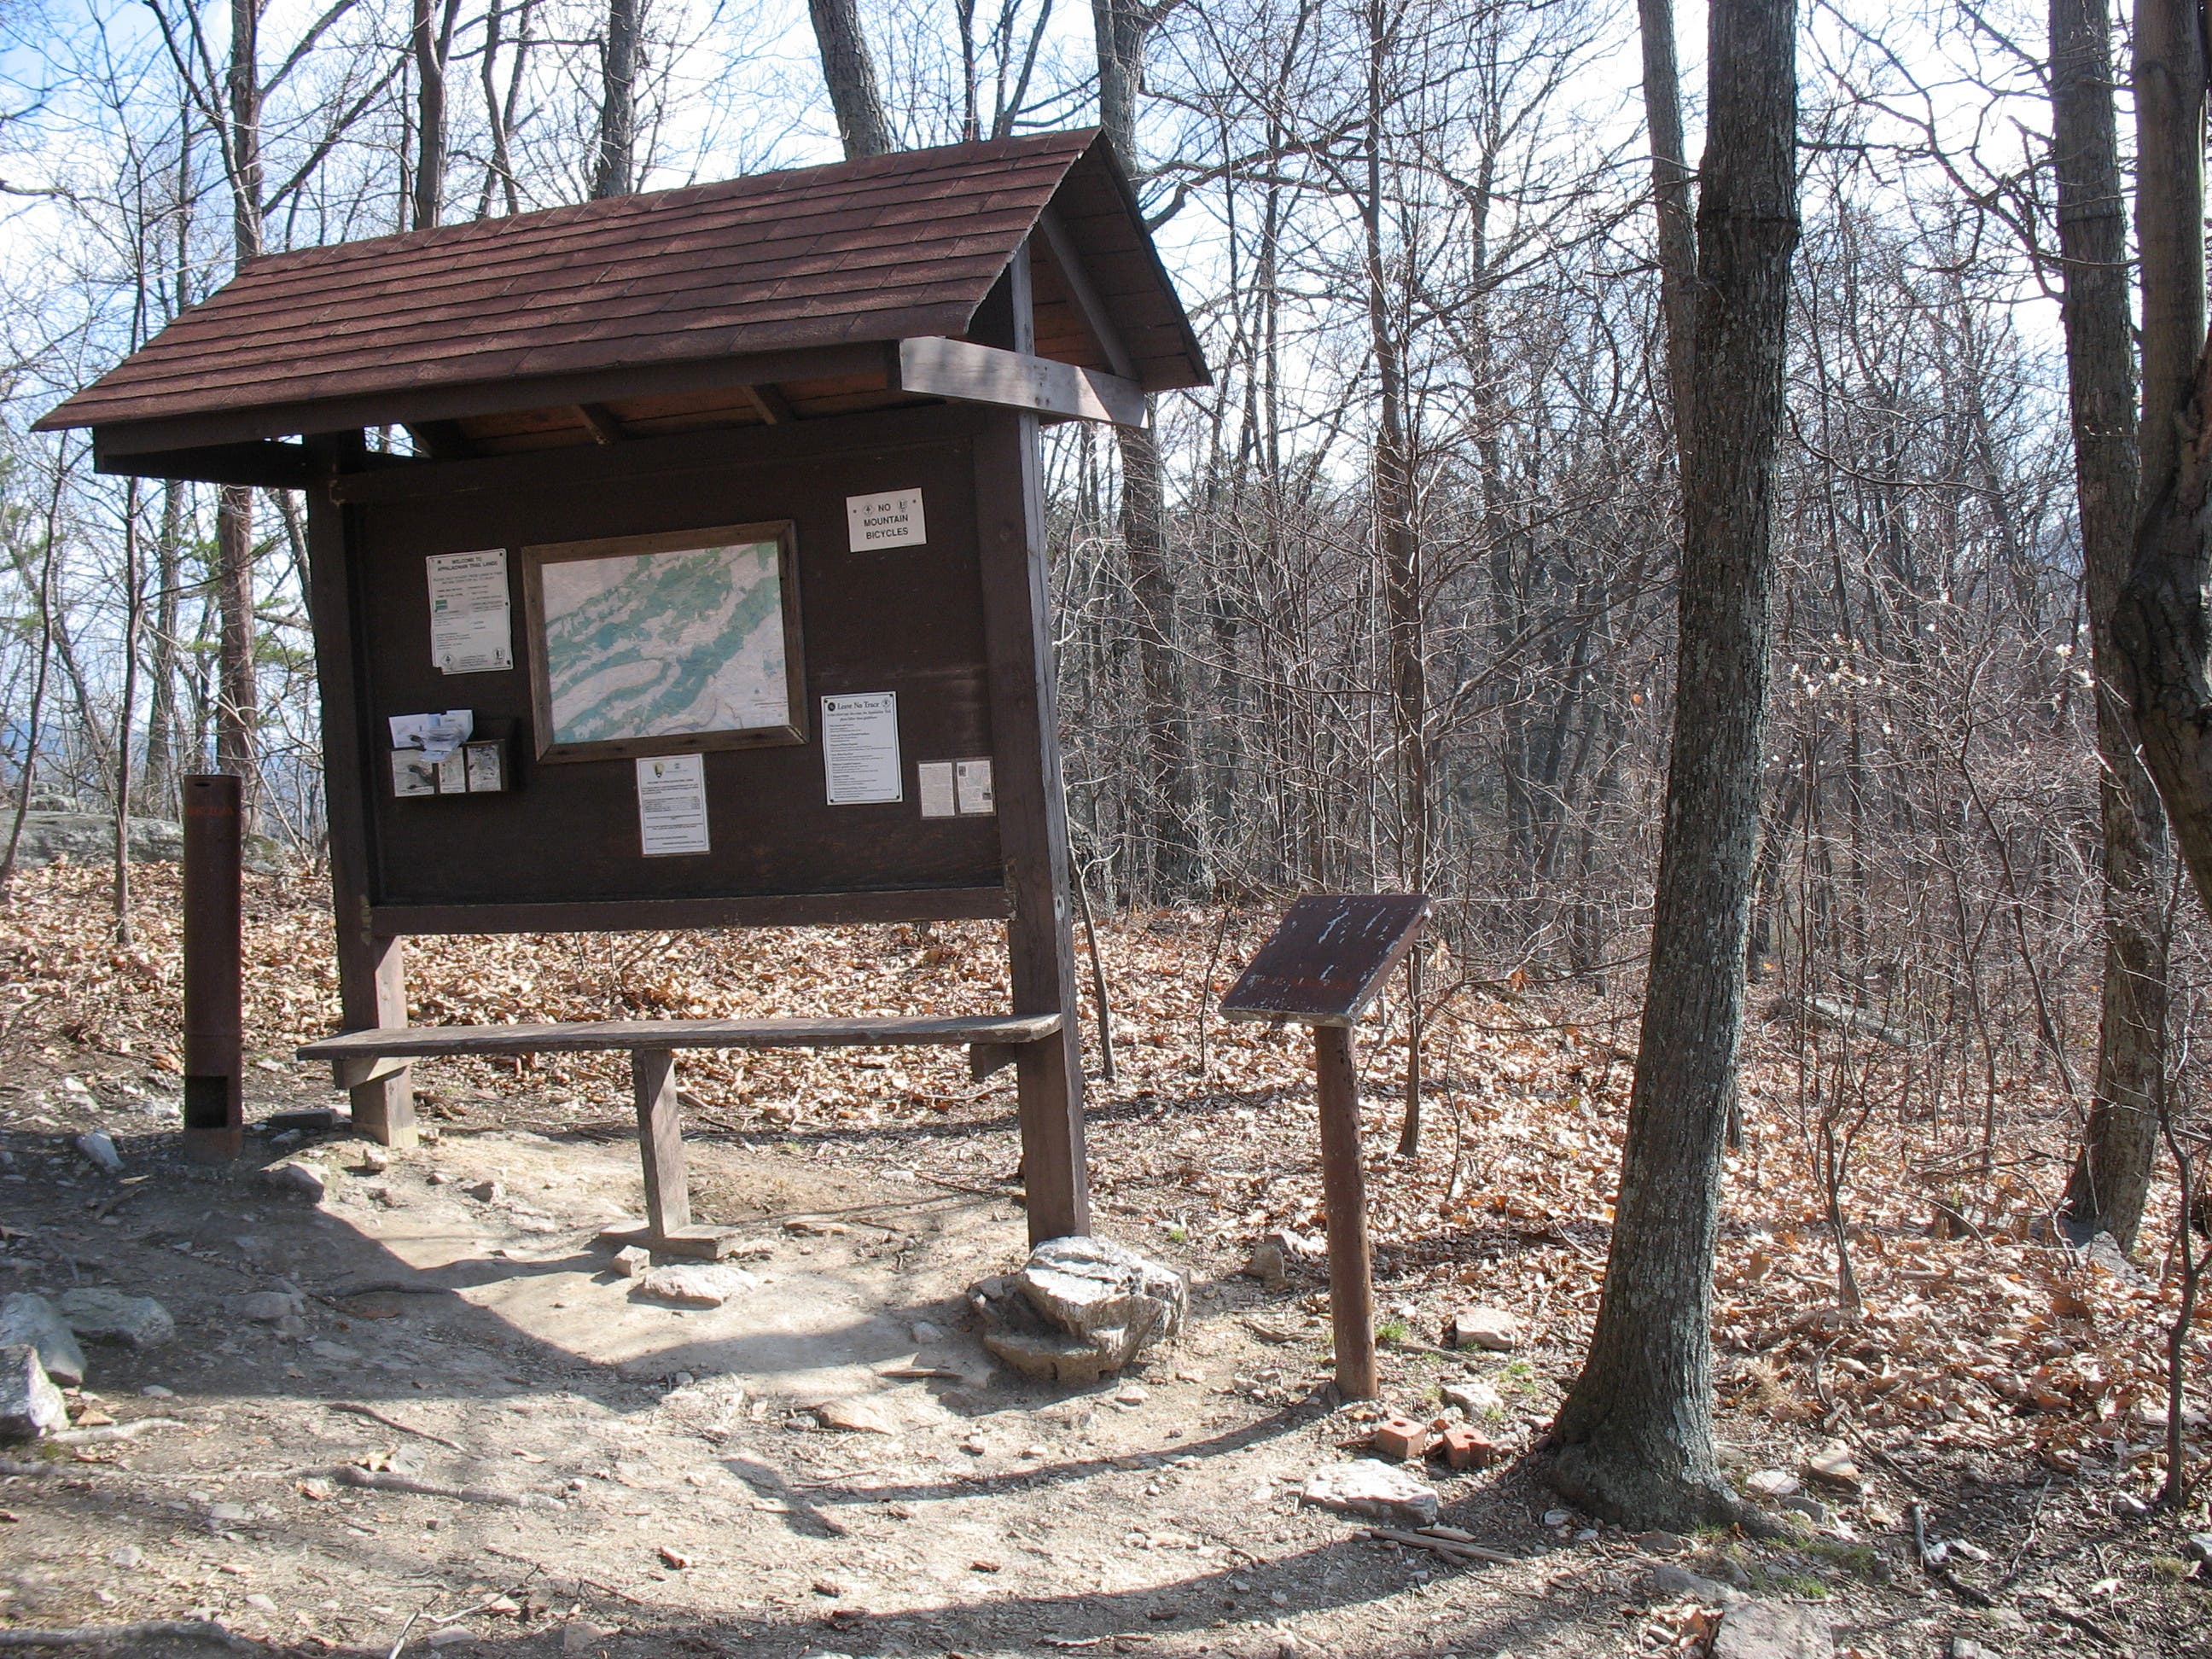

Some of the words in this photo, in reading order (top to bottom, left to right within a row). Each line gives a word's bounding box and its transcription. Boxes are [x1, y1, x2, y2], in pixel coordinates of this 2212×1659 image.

[877, 504, 891, 512] NO
[864, 515, 908, 527] MOUNTAIN
[866, 527, 909, 539] BICYCLES
